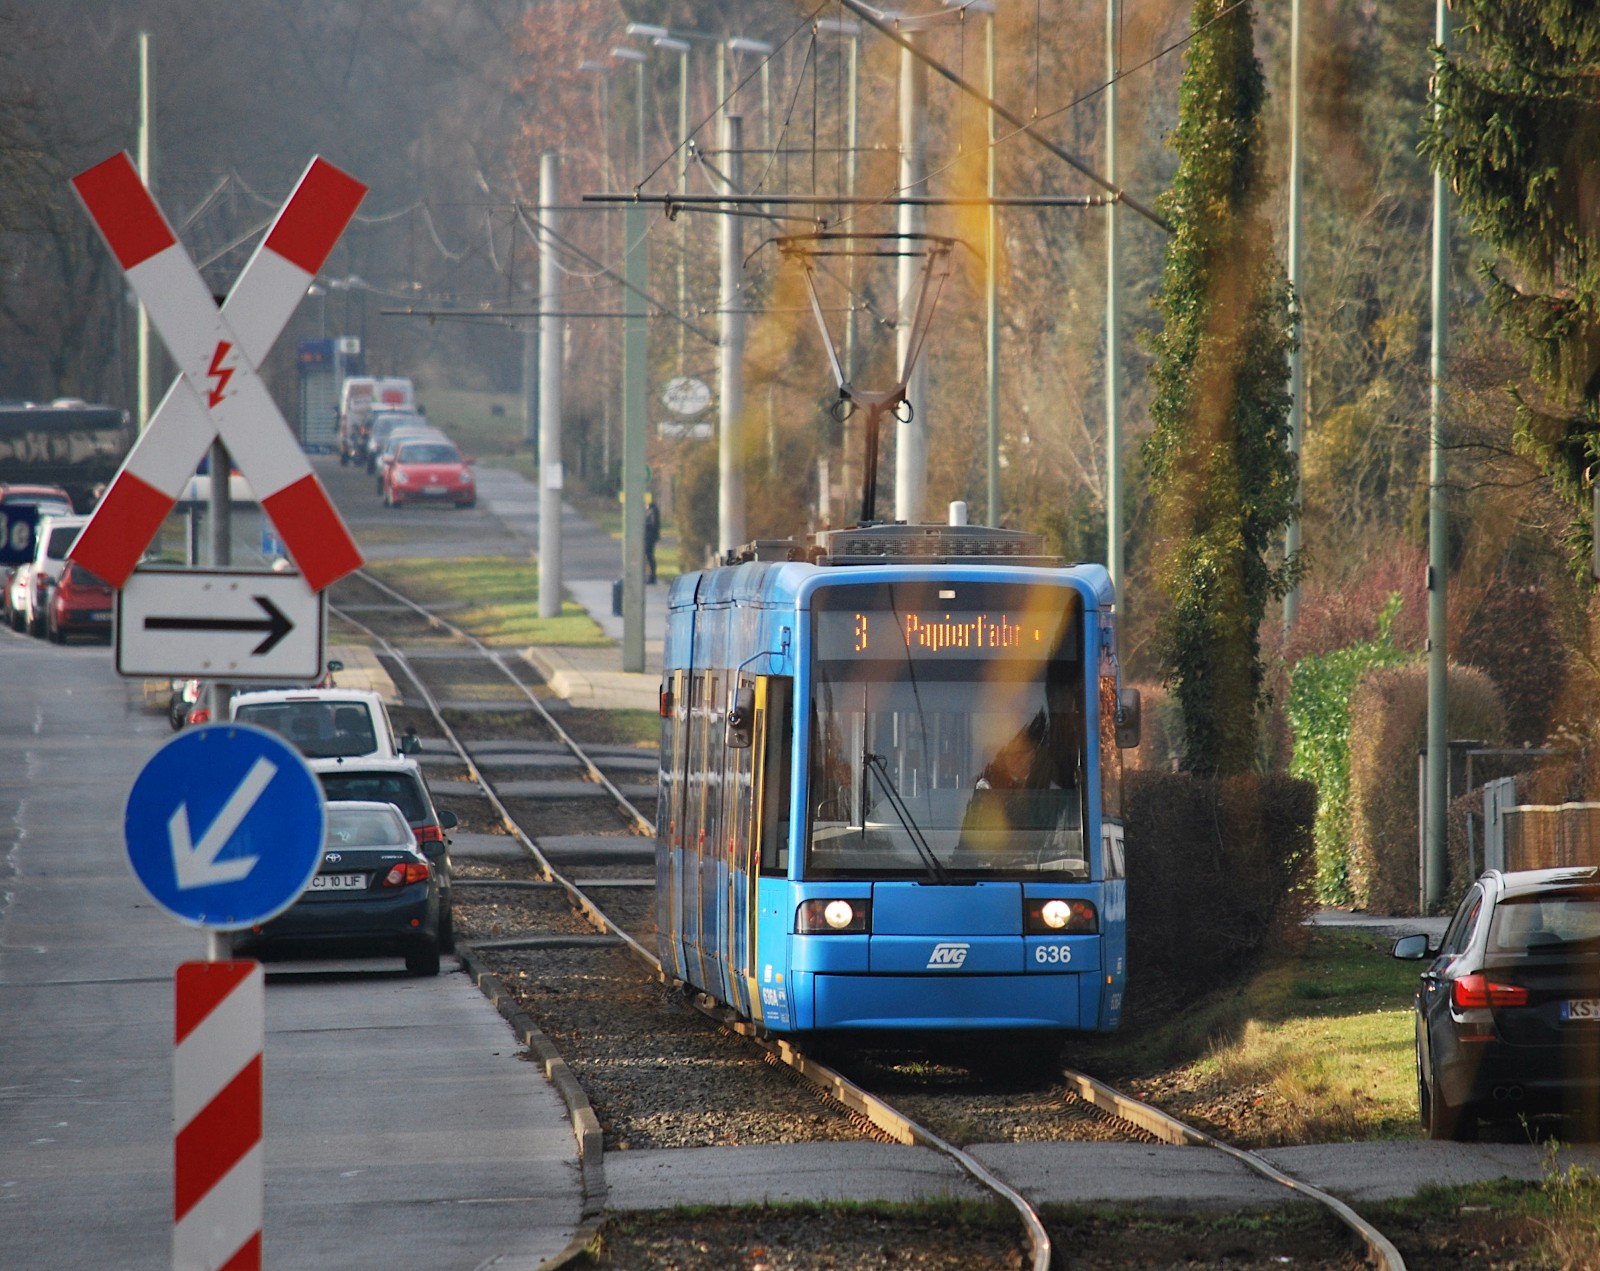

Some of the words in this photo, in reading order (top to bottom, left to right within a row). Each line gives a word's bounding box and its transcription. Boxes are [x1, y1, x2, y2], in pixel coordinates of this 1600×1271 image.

[855, 613, 868, 651] 3
[312, 876, 326, 888] CJ
[330, 875, 341, 887] 10
[344, 875, 361, 887] LIF
[927, 946, 969, 965] KVG
[1035, 945, 1071, 963] 636
[1569, 1001, 1591, 1017] KS
